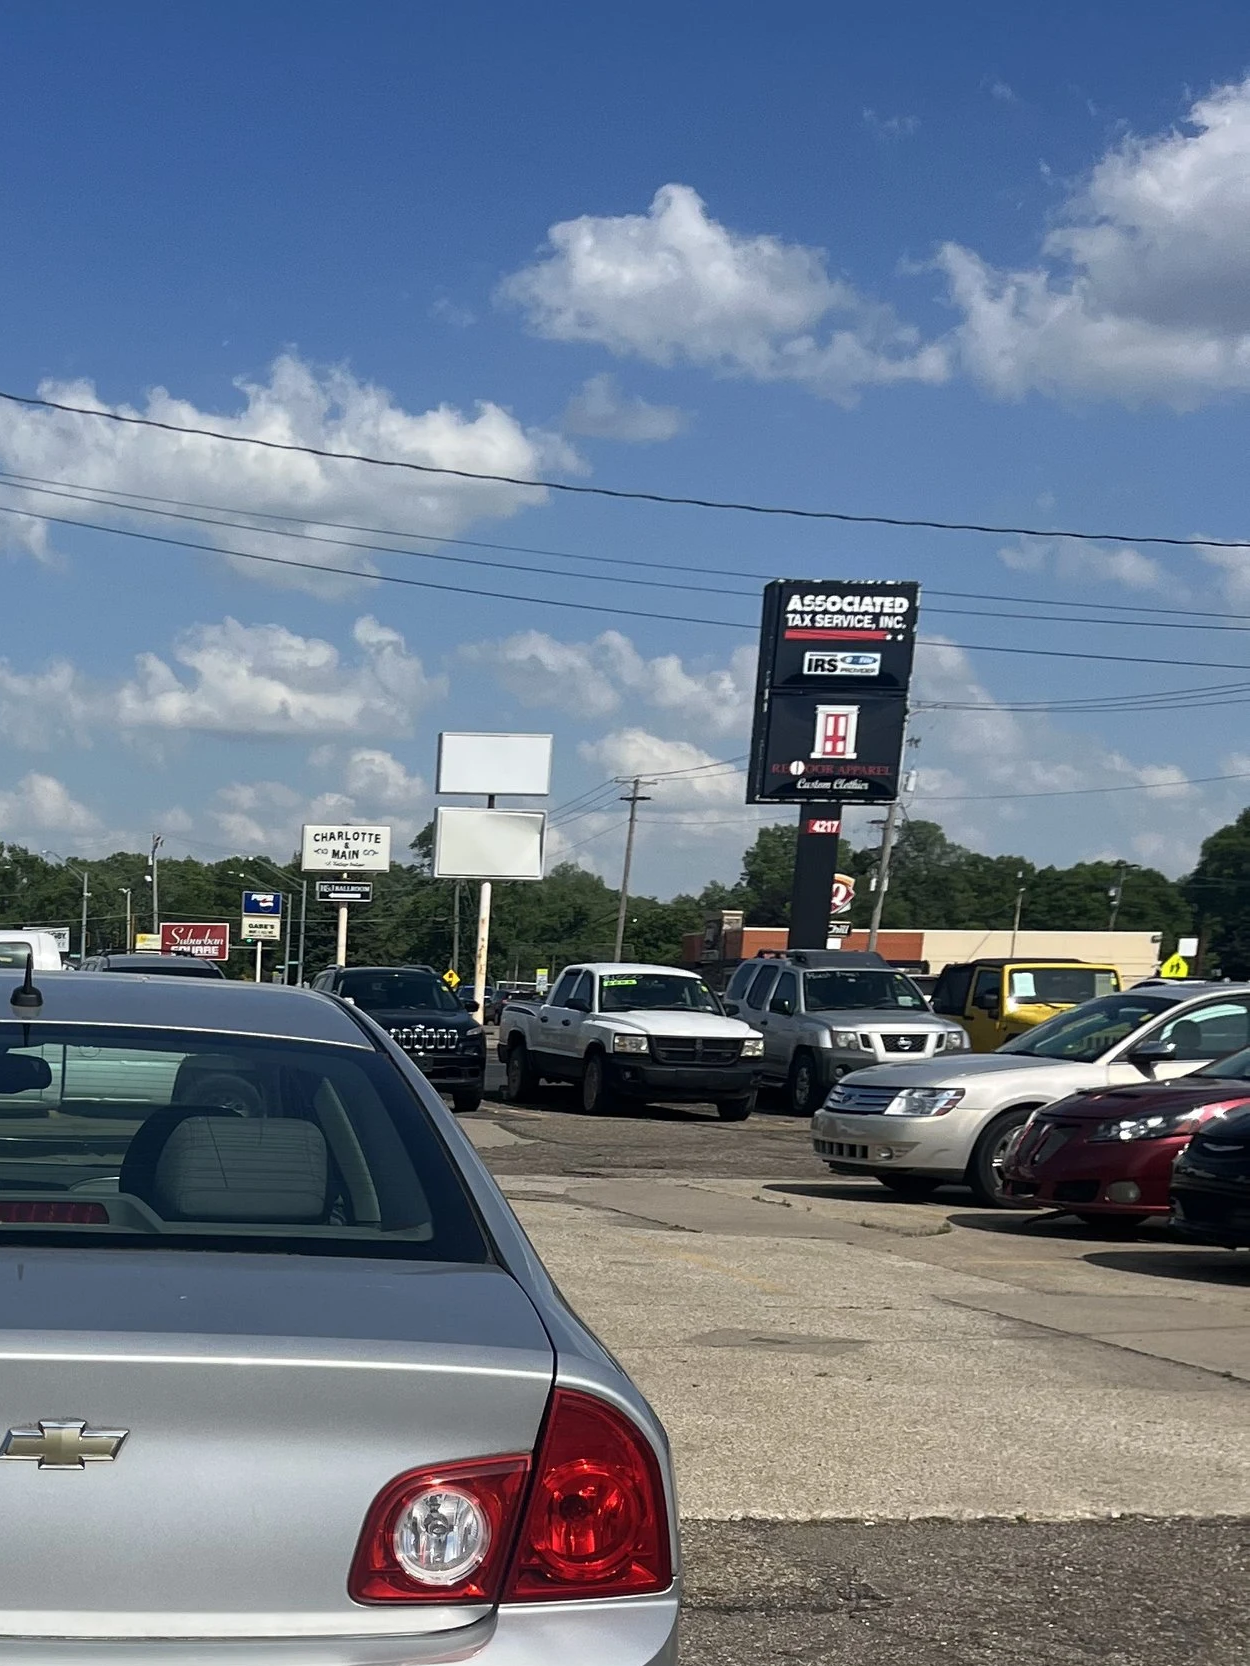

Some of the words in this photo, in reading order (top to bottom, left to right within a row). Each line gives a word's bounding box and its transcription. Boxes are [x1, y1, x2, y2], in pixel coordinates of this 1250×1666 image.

[786, 595, 910, 613] ASSOCIATED
[786, 614, 813, 627] TAX
[814, 614, 876, 630] SERVICE,
[879, 615, 907, 629] INC.
[807, 658, 838, 672] IRS
[812, 820, 839, 833] 4217
[313, 831, 381, 844] CHARLOTTE
[331, 849, 360, 860] MAIN
[165, 926, 224, 945] Suburban
